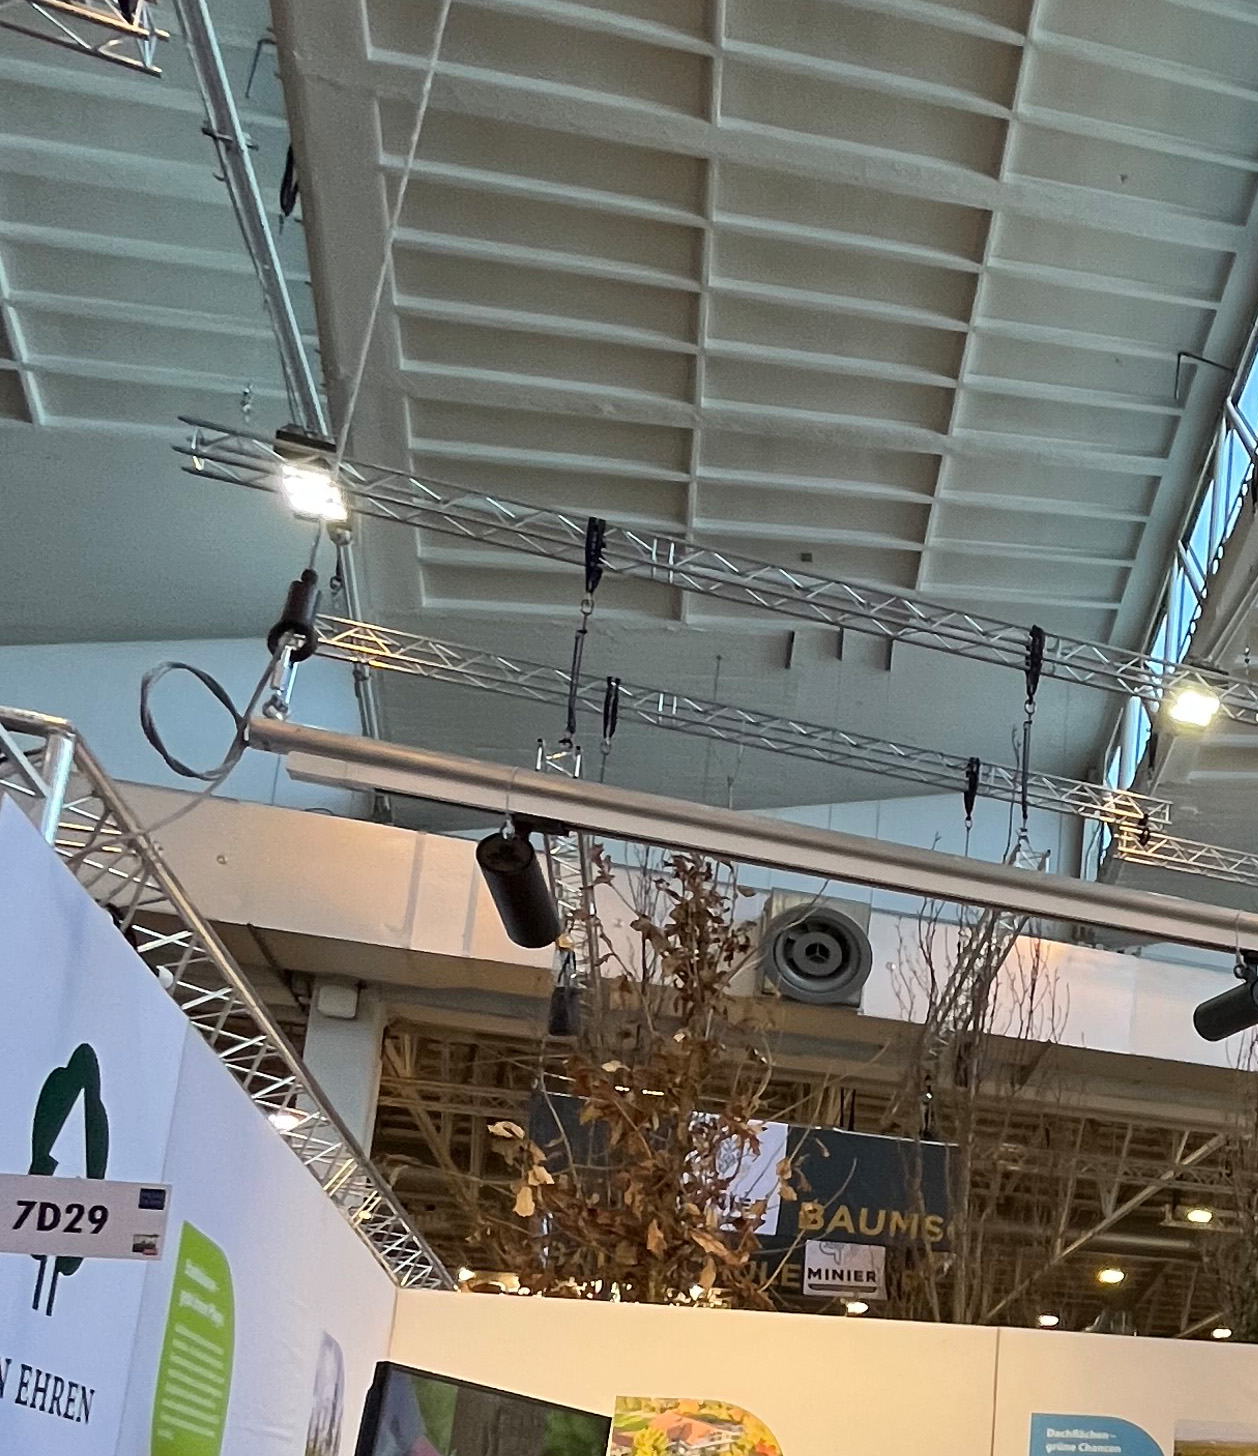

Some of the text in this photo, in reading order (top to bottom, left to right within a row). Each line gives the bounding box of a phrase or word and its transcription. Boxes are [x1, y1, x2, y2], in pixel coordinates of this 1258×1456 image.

[12, 1200, 109, 1235] 7D29
[807, 1267, 877, 1283] MINIER
[15, 1363, 95, 1425] EHREN
